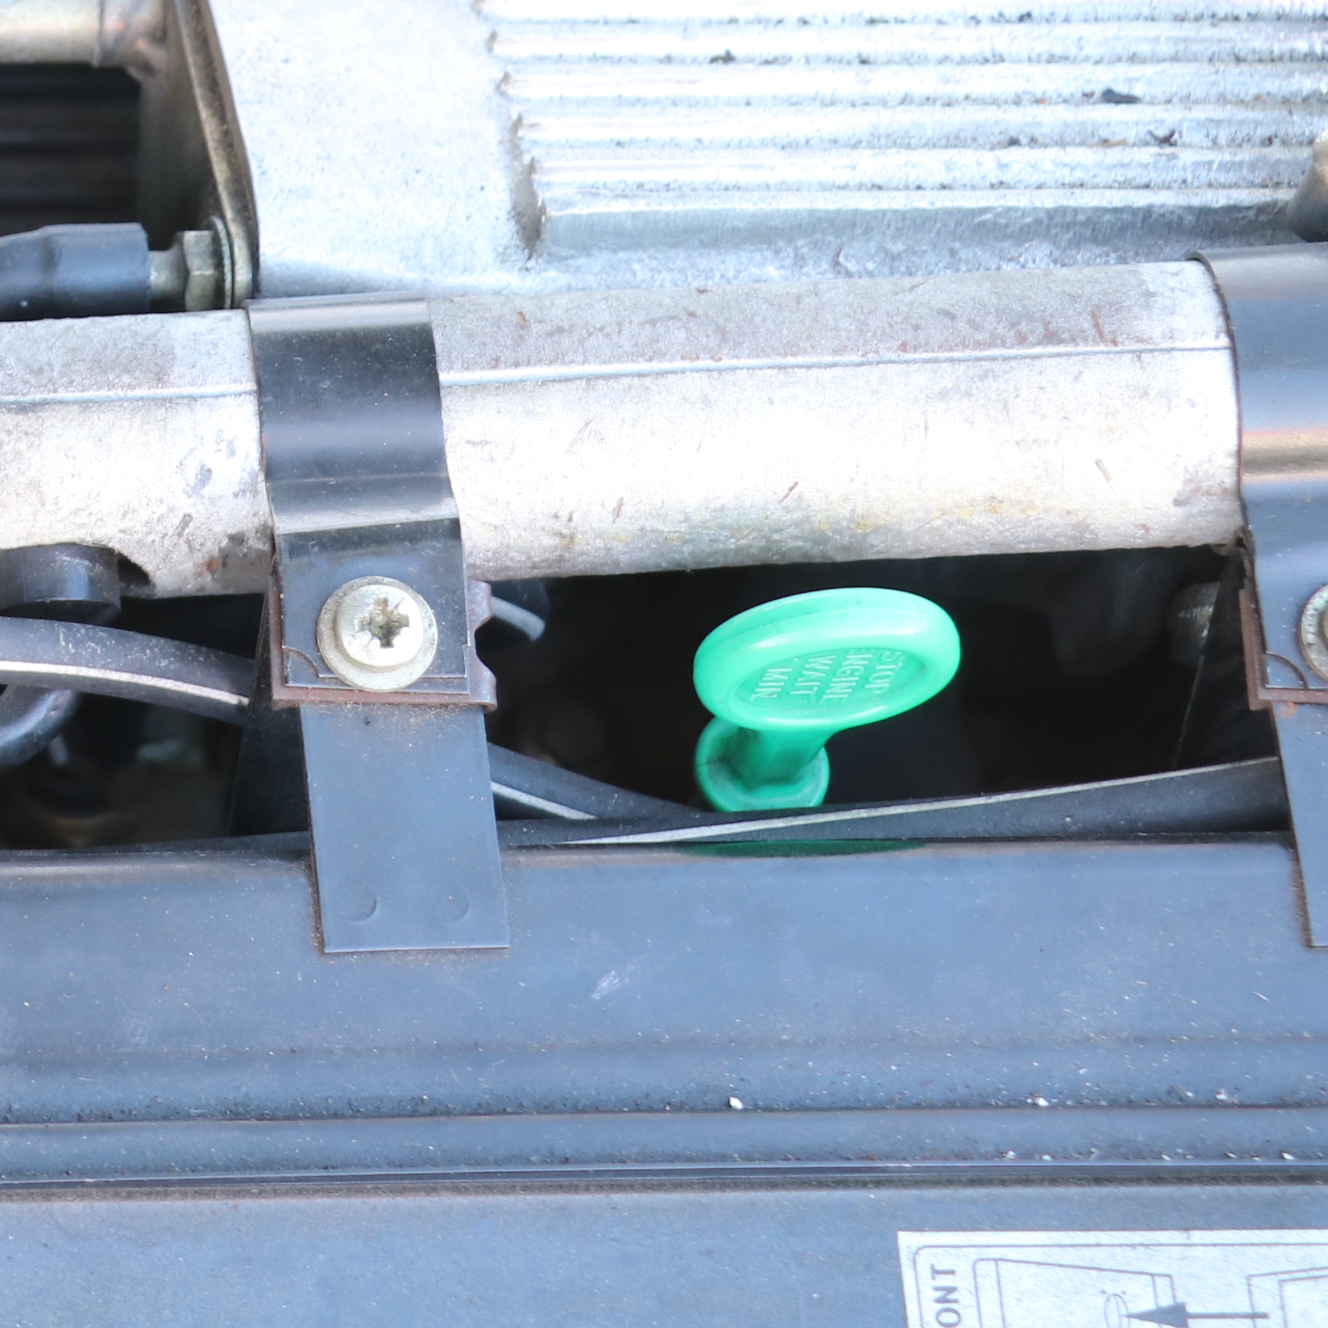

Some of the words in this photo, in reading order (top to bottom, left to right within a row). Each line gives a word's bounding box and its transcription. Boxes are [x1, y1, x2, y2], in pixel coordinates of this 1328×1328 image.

[790, 654, 837, 703] WAIT
[864, 650, 908, 694] STOP
[930, 1264, 962, 1328] ONT
